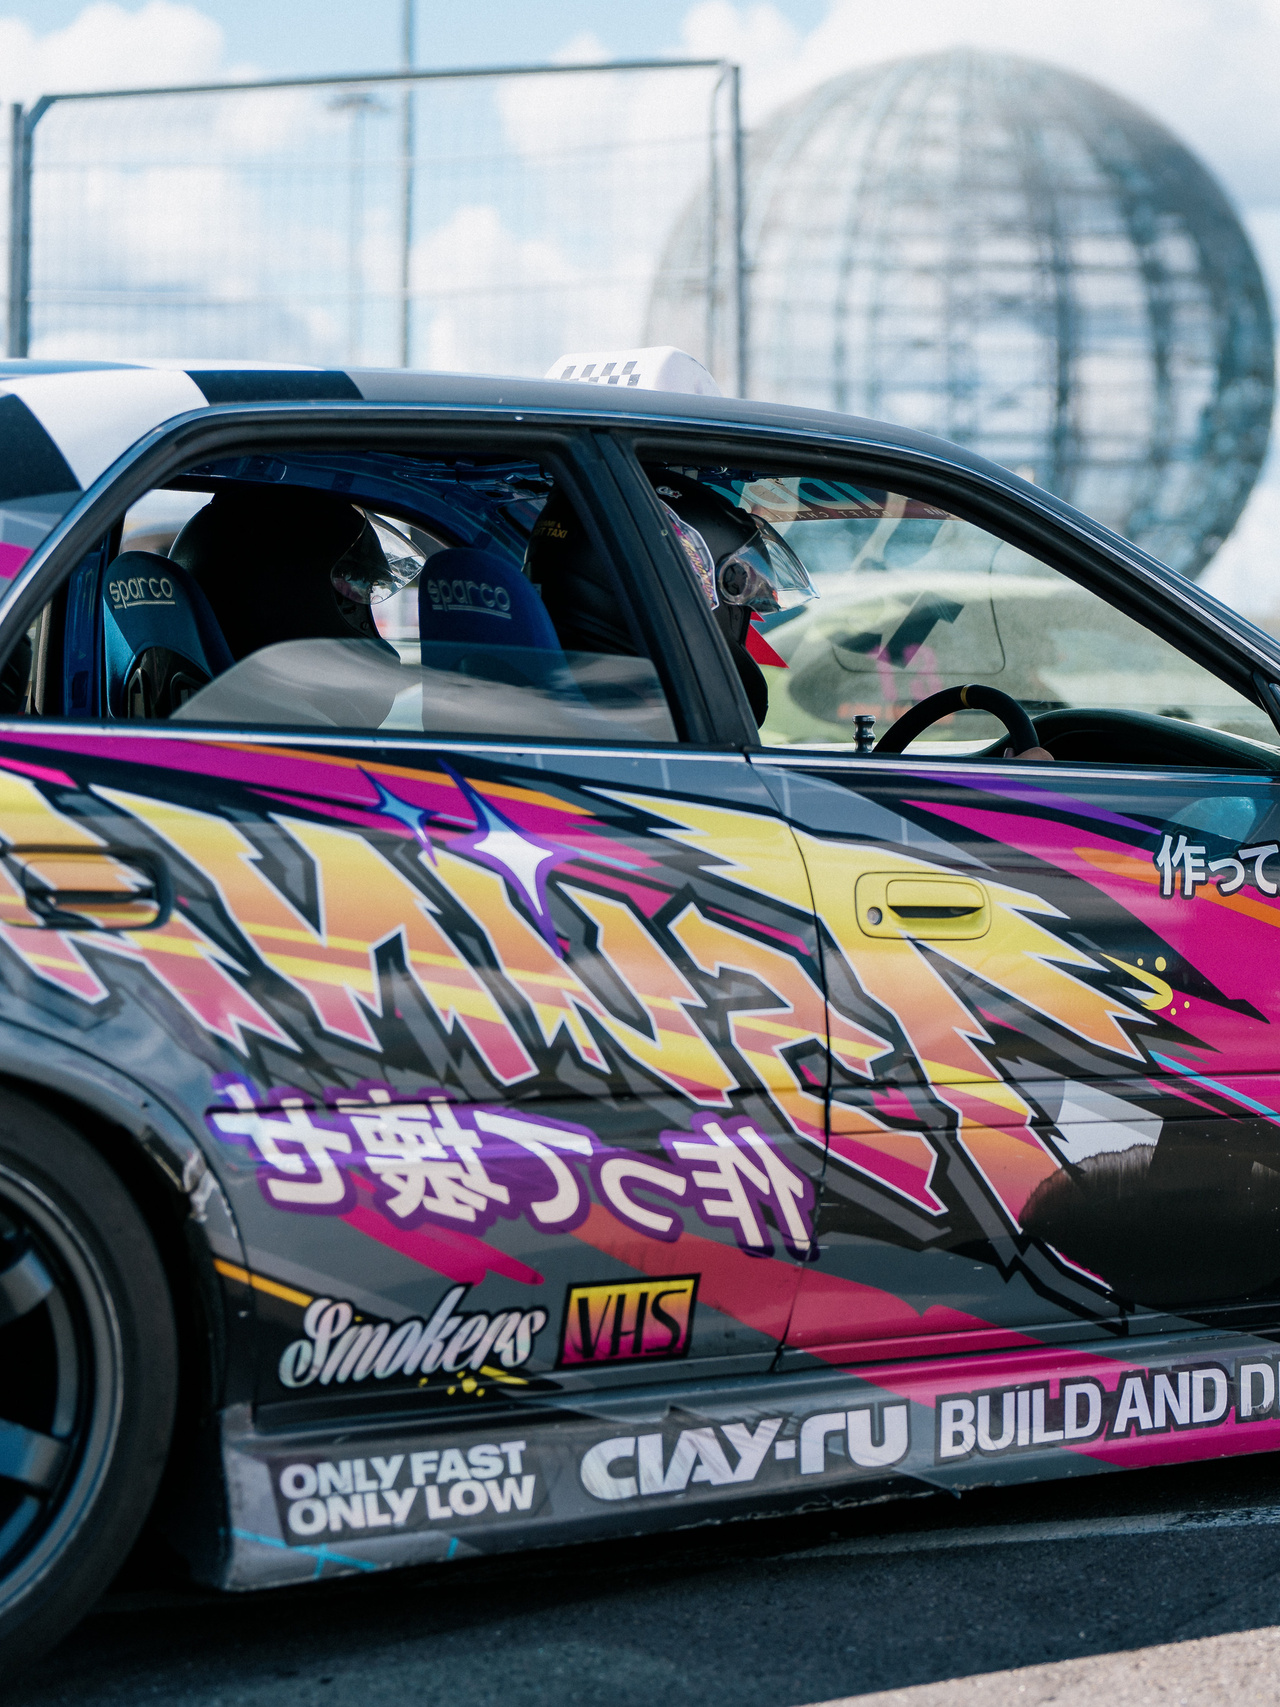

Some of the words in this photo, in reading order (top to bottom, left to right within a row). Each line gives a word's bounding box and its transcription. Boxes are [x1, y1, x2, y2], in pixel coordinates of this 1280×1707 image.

[109, 577, 174, 609] sparco
[427, 578, 512, 612] sparco
[278, 1285, 547, 1390] Smokers
[574, 1287, 692, 1360] VHS
[939, 1380, 1100, 1459] BUILD
[1112, 1367, 1229, 1434] AND
[279, 1454, 405, 1499] ONLY
[409, 1441, 527, 1488] FAST
[286, 1494, 418, 1537] ONLY
[425, 1474, 537, 1521] LOW
